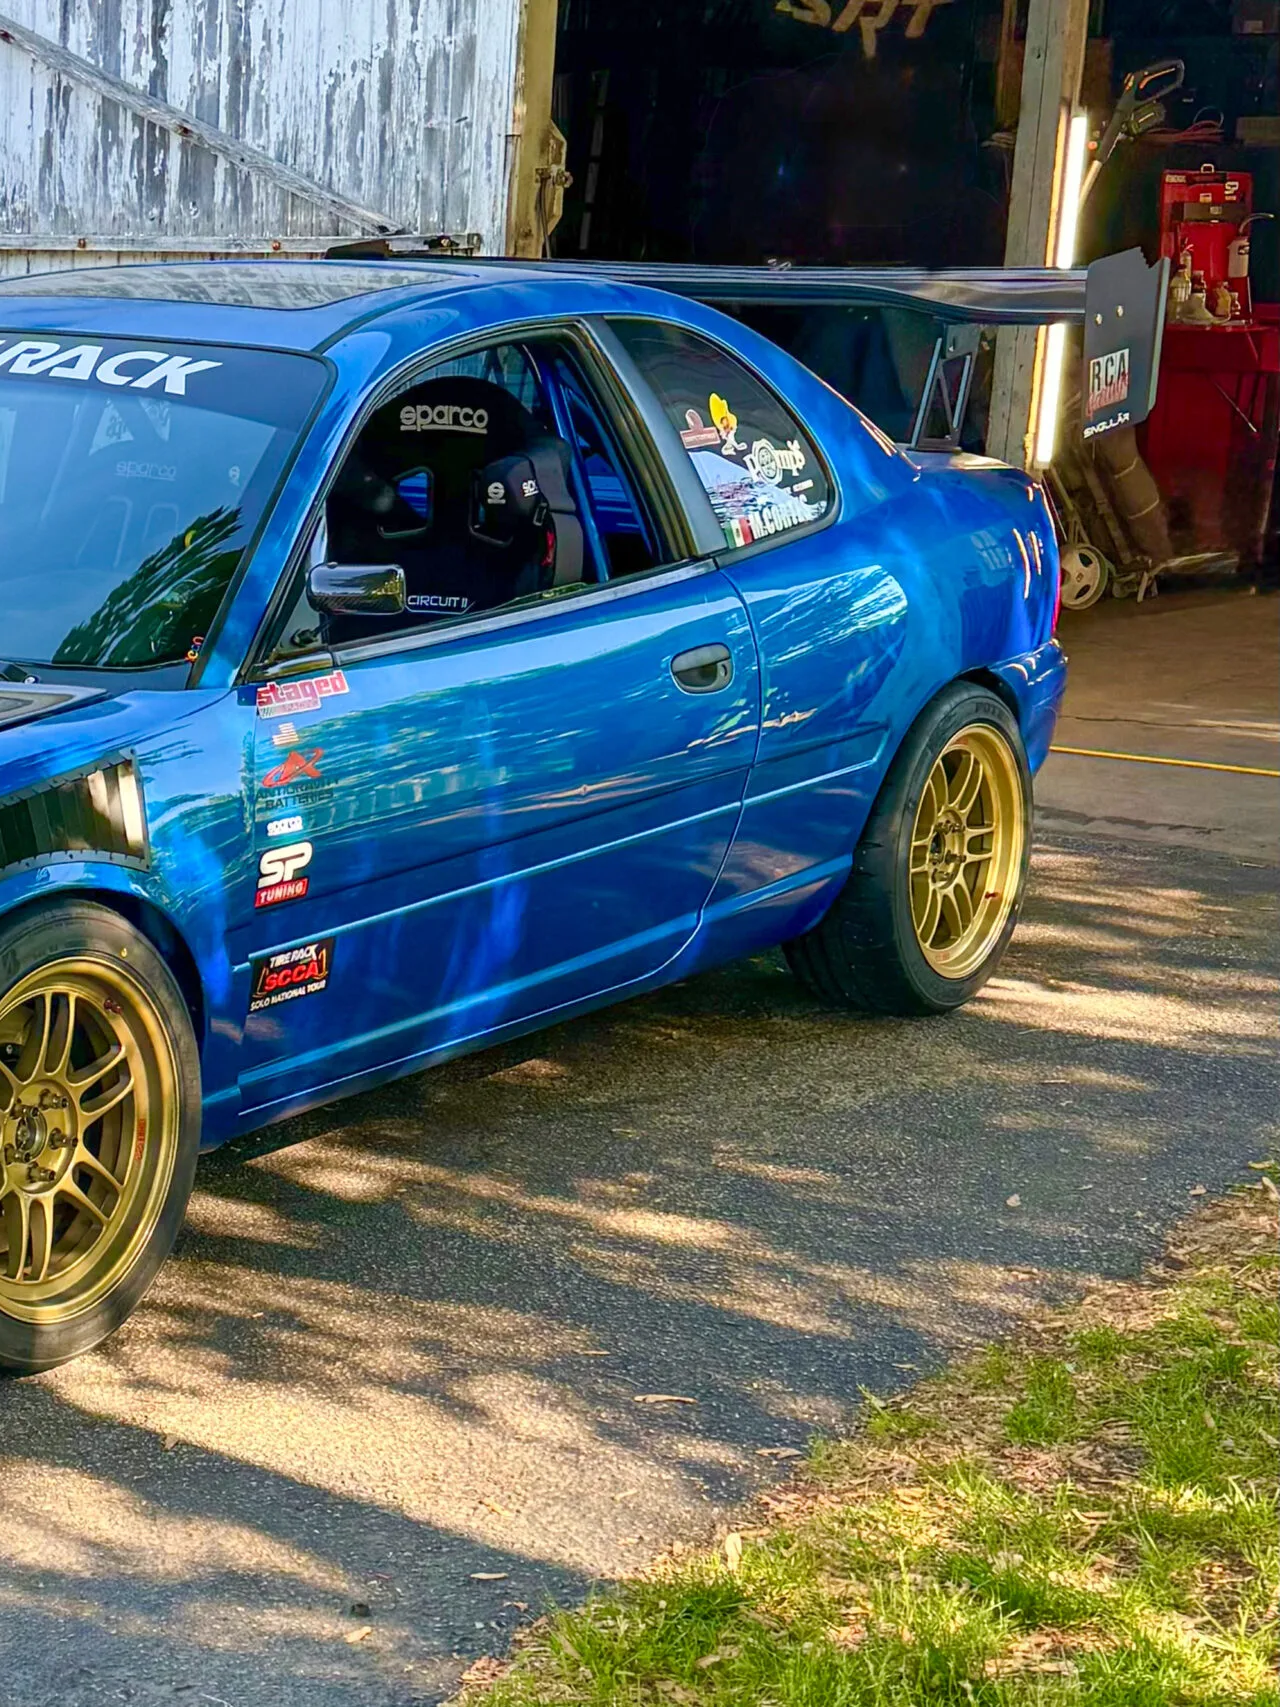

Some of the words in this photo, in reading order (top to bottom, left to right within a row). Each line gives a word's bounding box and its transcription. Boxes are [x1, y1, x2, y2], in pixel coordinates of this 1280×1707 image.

[1092, 352, 1127, 392] RCA
[400, 405, 488, 432] sparco
[407, 595, 461, 607] CIRCUIT
[257, 672, 348, 707] staged
[258, 842, 312, 888] SP
[260, 881, 303, 903] TUNING
[270, 951, 292, 968] TIRE
[291, 944, 319, 963] RACK
[264, 962, 320, 991] SCCA
[250, 998, 270, 1011] SOLO
[271, 985, 306, 1005] NATIONAL
[307, 979, 326, 994] TOUR
